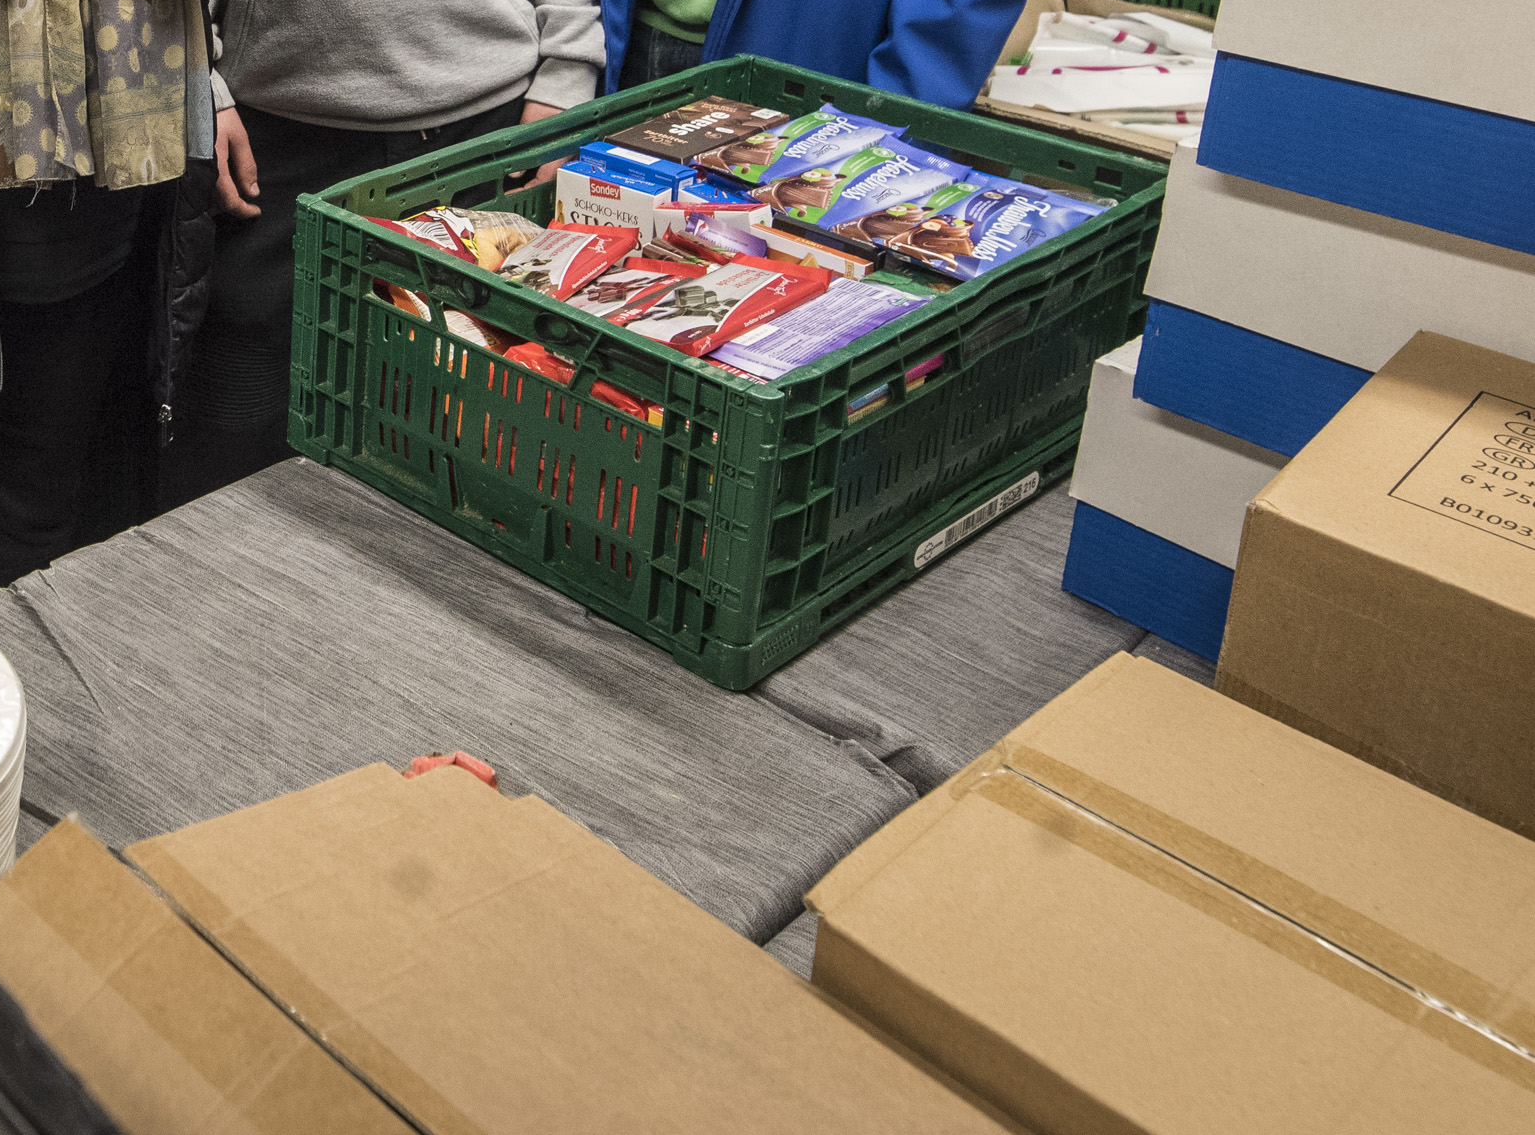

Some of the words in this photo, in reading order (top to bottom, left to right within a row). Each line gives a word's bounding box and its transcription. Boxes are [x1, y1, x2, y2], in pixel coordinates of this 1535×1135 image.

[669, 111, 731, 137] share
[783, 117, 859, 159] Haselnuss
[841, 154, 921, 201] Haselnuss
[590, 183, 620, 200] Sondey
[574, 197, 639, 226] SCHOKO-KEKS
[1505, 437, 1534, 453] FR
[1492, 451, 1527, 468] GR
[1460, 474, 1477, 484] 6
[1471, 460, 1519, 481] 210
[1023, 478, 1037, 494] 216
[1439, 497, 1535, 541] B01093
